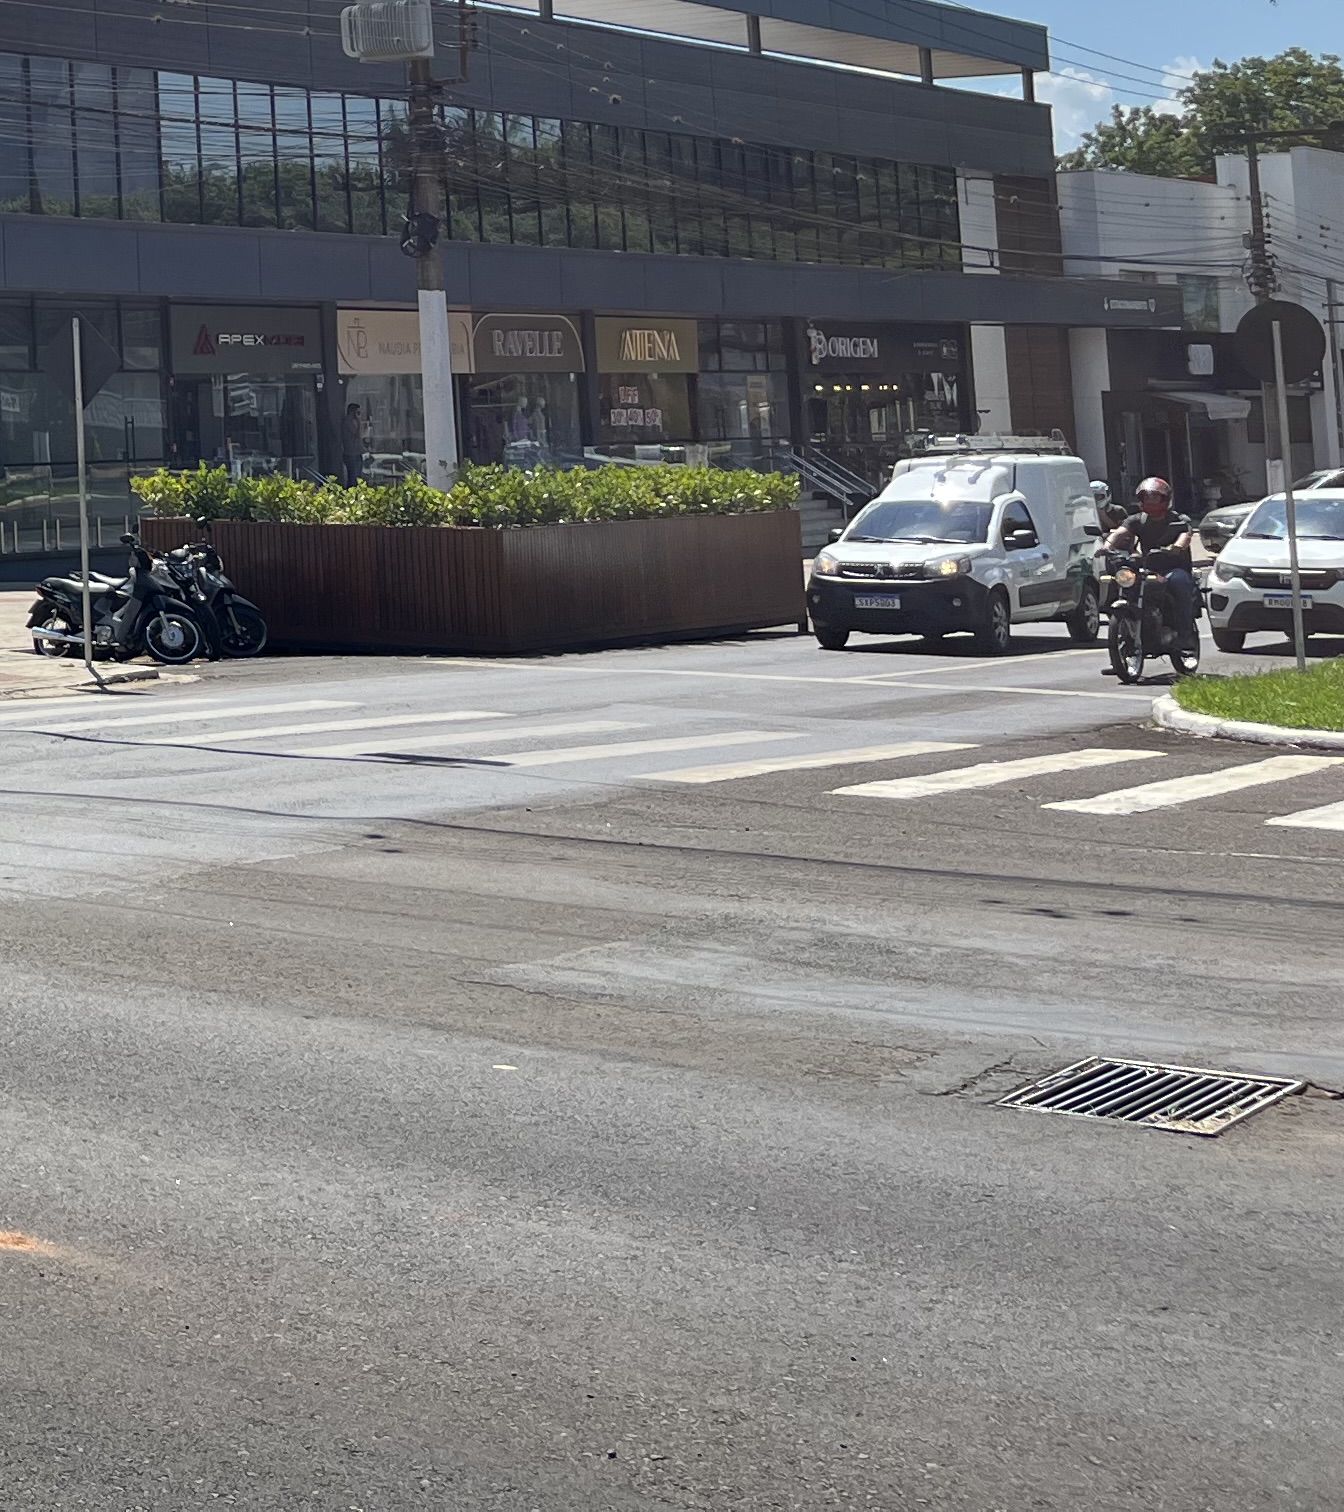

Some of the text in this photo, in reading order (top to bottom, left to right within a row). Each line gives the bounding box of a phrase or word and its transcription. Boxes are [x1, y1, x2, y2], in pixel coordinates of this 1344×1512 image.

[218, 334, 264, 346] APEX
[492, 330, 563, 356] RAVELLE
[828, 337, 879, 358] ORIGEM
